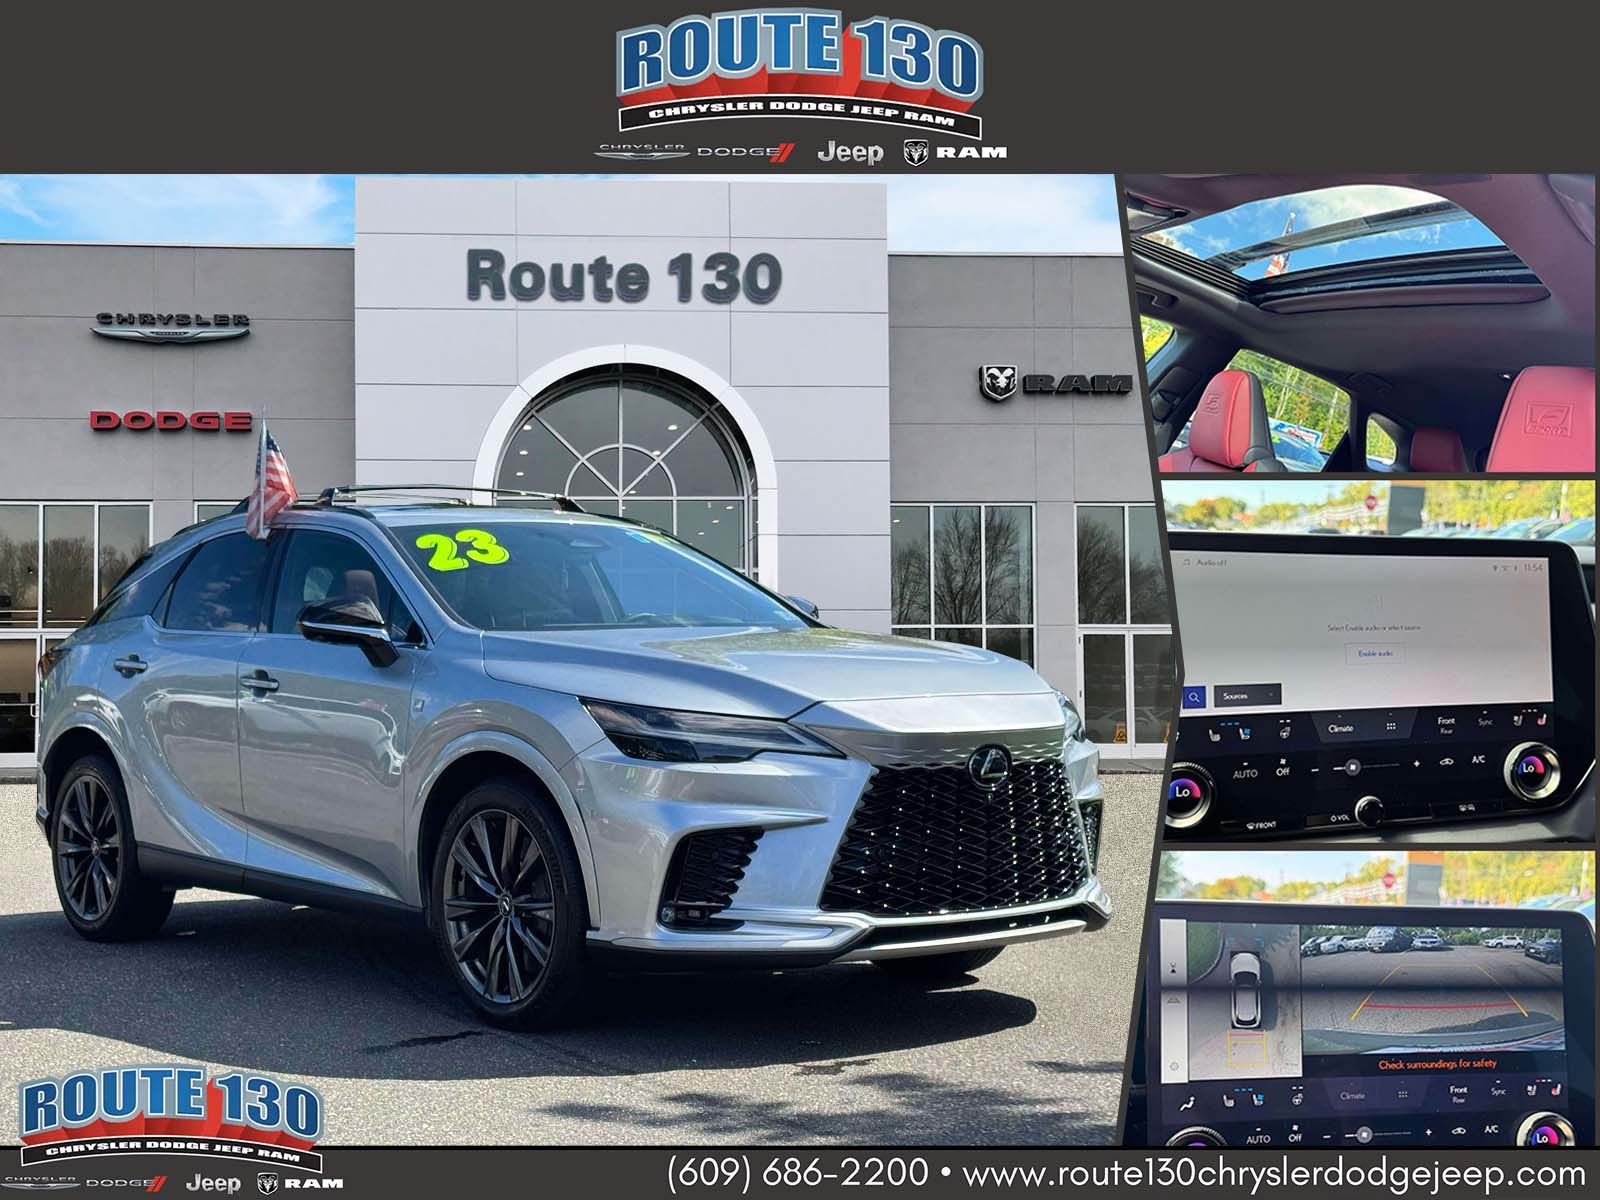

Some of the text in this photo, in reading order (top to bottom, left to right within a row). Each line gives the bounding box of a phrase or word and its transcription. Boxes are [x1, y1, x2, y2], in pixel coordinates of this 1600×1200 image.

[467, 248, 783, 305] Route 130
[96, 312, 251, 326] CHRYSLER
[1023, 374, 1134, 394] RAM
[89, 410, 252, 432] DODGE
[415, 528, 511, 572] 23
[1437, 716, 1456, 726] Front
[1477, 718, 1494, 727] Sync
[1328, 723, 1354, 734] Climate
[1471, 755, 1486, 765] A/C
[1276, 767, 1290, 777] Off
[1523, 762, 1535, 773] Lo
[1232, 768, 1259, 779] AUTO
[1175, 785, 1190, 798] Lo
[1255, 820, 1277, 830] FRONT
[1378, 1058, 1498, 1071] Check surroundings for safety
[1449, 1085, 1468, 1094] Front
[1491, 1087, 1507, 1096] Sync
[1340, 1091, 1366, 1101] Climate
[1484, 1124, 1499, 1134] A/C
[1246, 1134, 1271, 1145] AUTO
[1288, 1133, 1302, 1143] Off
[1536, 1133, 1549, 1144] Lo
